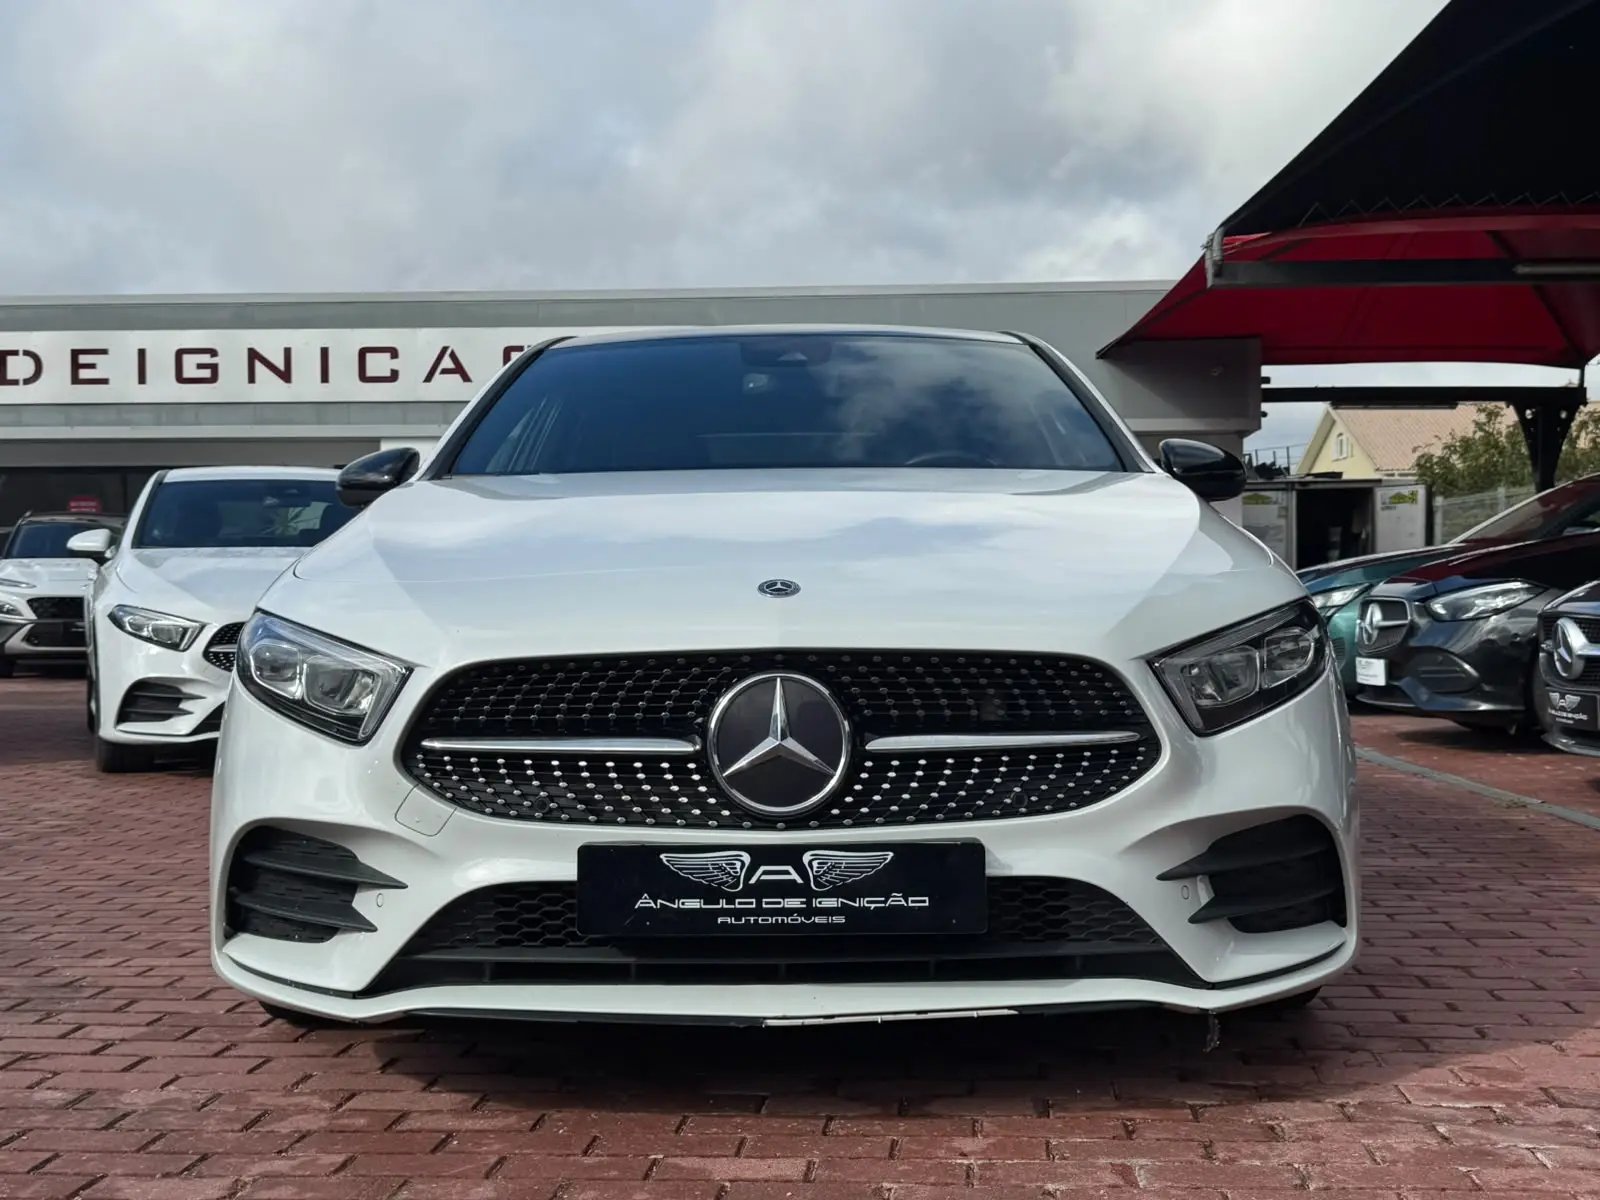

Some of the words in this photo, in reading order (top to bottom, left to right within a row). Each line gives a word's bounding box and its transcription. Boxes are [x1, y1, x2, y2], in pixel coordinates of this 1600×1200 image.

[748, 865, 804, 884] A
[634, 893, 756, 909] ÂNGULO
[762, 898, 807, 908] DE
[812, 892, 929, 910] IGNIÇÃO
[717, 913, 846, 924] AUTOMÓVEIS
